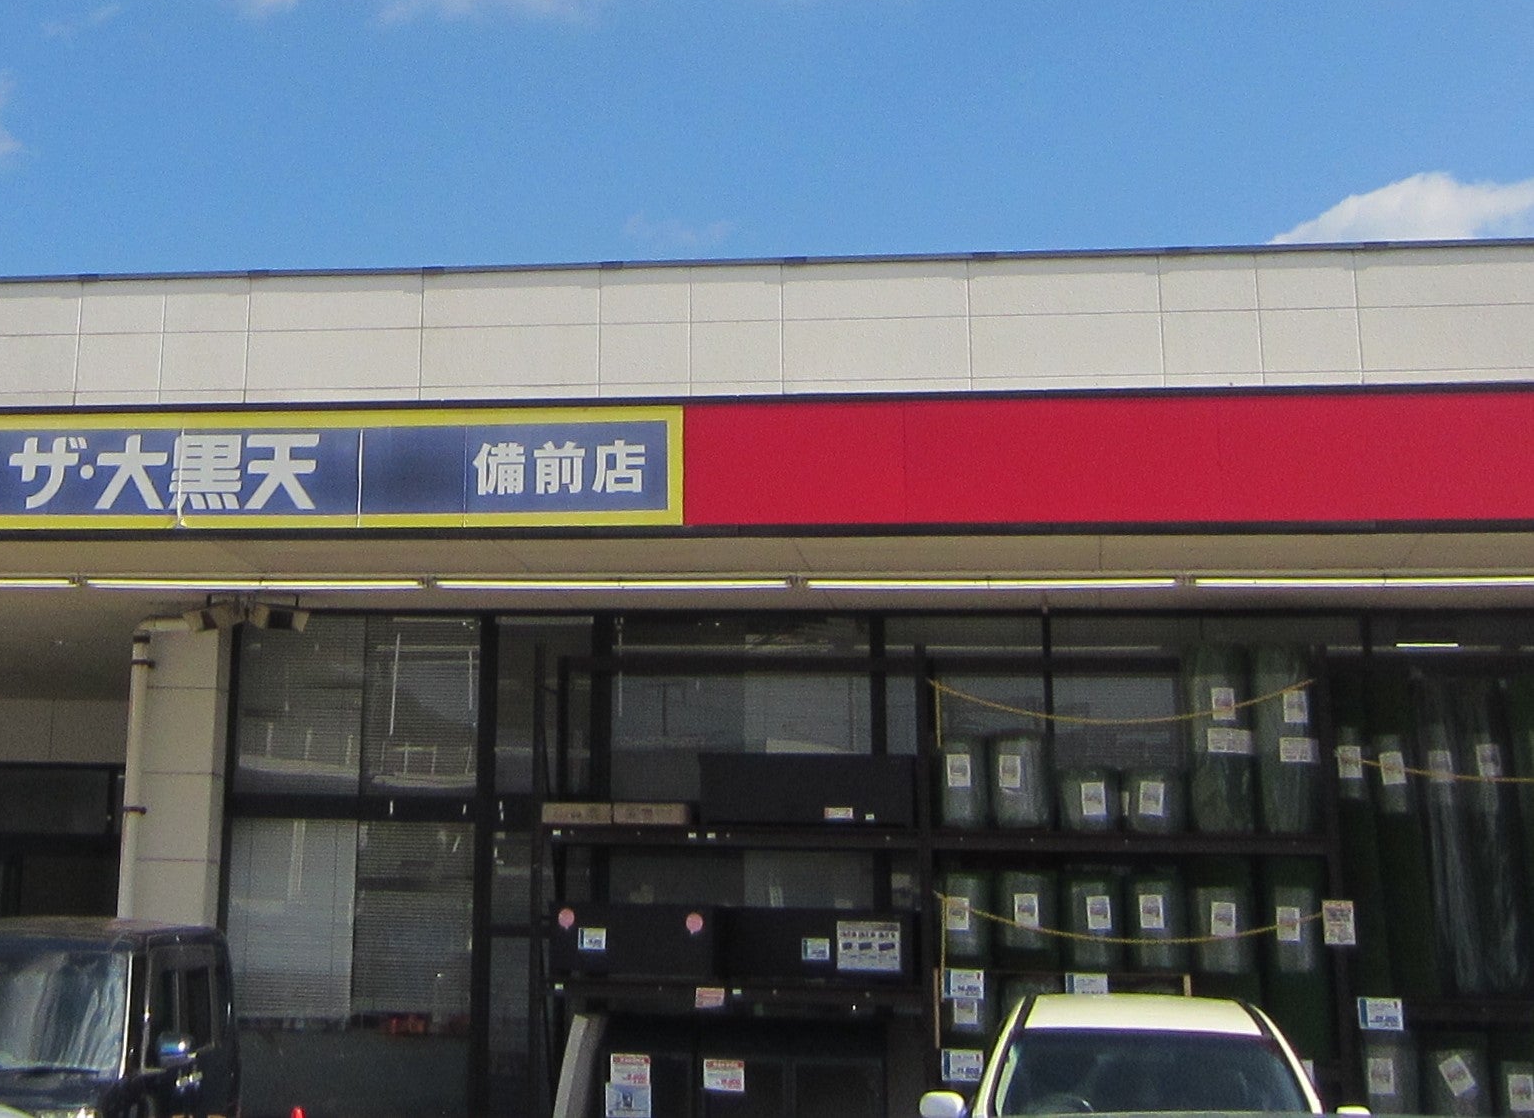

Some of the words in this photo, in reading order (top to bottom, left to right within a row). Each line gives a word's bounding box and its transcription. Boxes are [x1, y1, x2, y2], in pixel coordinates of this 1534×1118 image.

[8, 433, 321, 510] ザ・大黒天
[472, 439, 646, 496] 備前店
